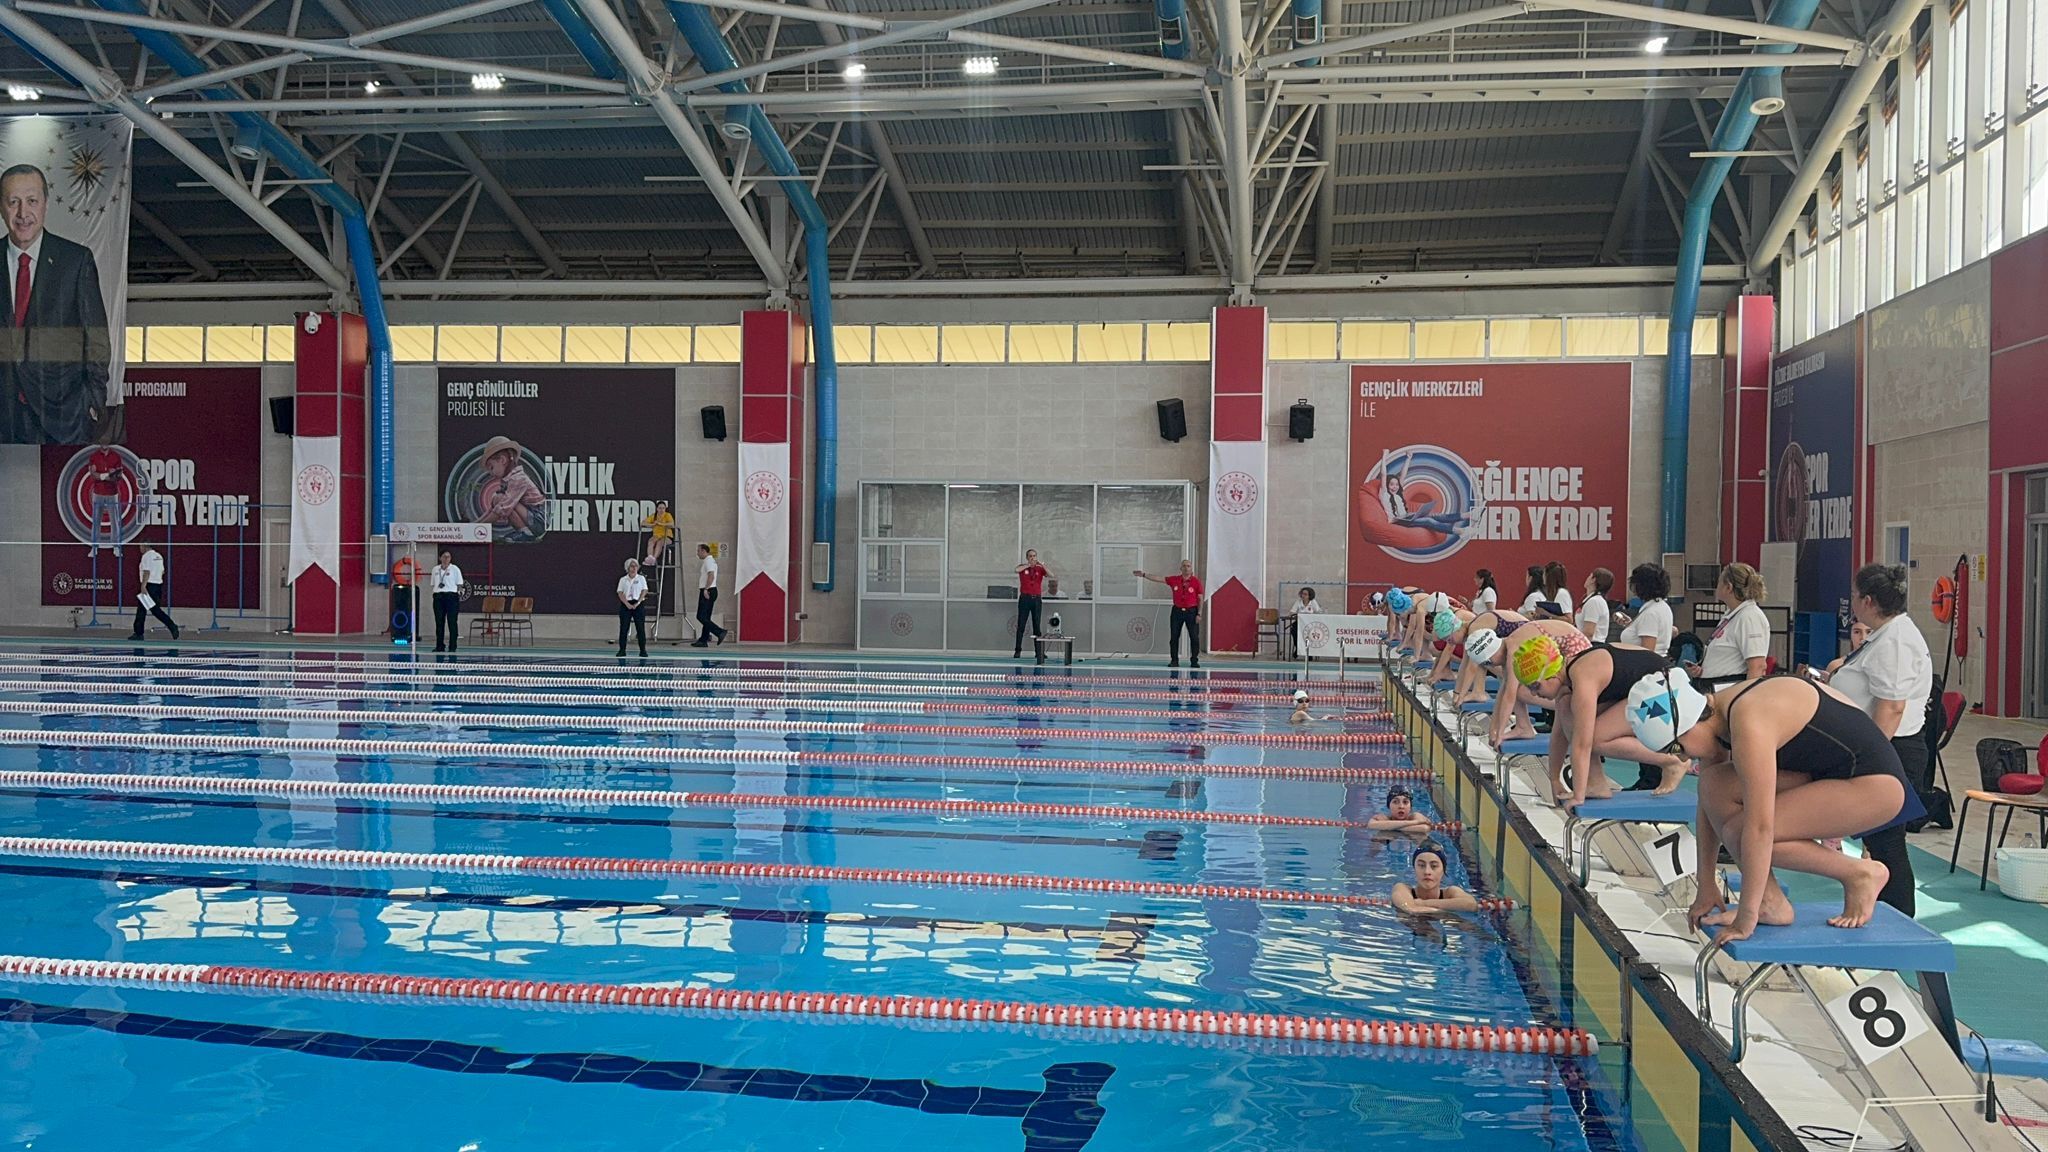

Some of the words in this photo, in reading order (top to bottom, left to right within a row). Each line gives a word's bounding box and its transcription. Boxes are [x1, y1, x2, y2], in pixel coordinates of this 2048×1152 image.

[134, 382, 187, 397] PROGRAMI
[447, 382, 474, 403] GENÇ
[476, 380, 538, 398] GÖNÜLLÜLER
[1360, 379, 1409, 400] GENÇLİK
[1412, 378, 1483, 397] MERKEZLERİ
[448, 400, 488, 417] PROJESİ
[491, 400, 505, 417] İLE
[1360, 400, 1376, 418] İLE
[136, 458, 195, 490] SPOR
[545, 456, 616, 495] İYİLİK
[1470, 460, 1583, 501] EĞLENCE
[1804, 452, 1829, 495] SPOR
[136, 495, 177, 526] HER
[182, 495, 249, 526] YERDE
[545, 500, 590, 532] HER
[595, 500, 668, 532] YERD
[1469, 506, 1520, 541] HER
[1528, 506, 1613, 541] YERDE
[1804, 500, 1820, 539] HER
[1822, 495, 1852, 539] YERDE
[1336, 628, 1370, 637] ESKİŞEHİR
[1356, 637, 1363, 645] İL
[1653, 831, 1683, 877] 7
[1848, 986, 1906, 1048] 8
